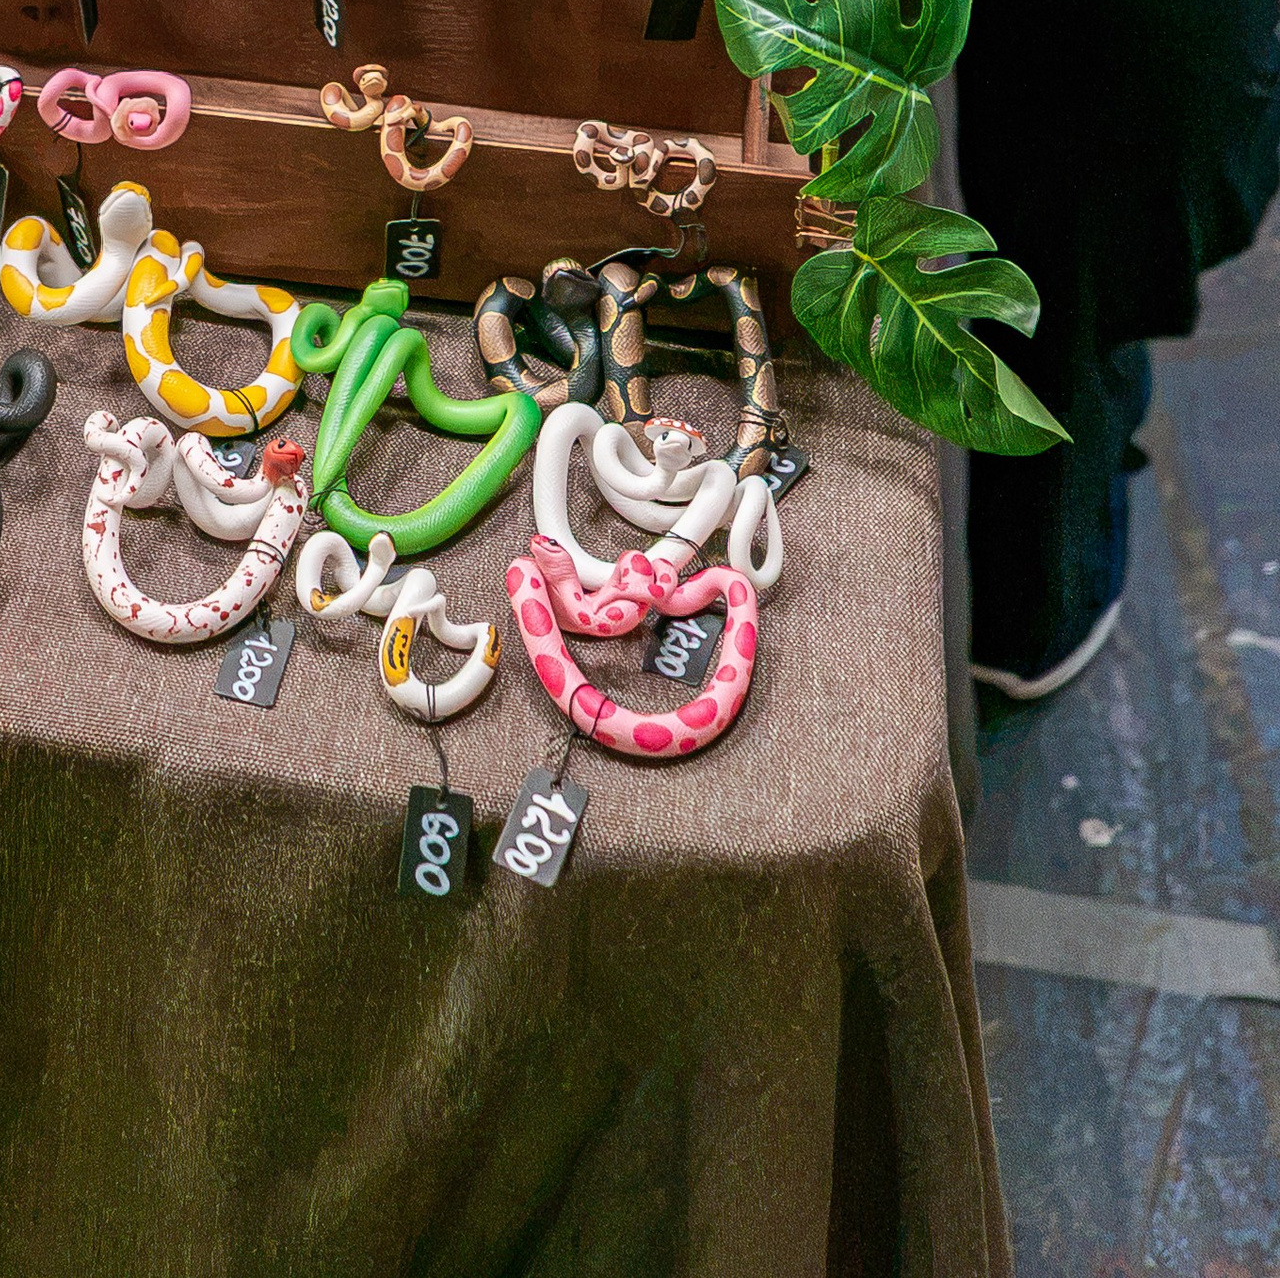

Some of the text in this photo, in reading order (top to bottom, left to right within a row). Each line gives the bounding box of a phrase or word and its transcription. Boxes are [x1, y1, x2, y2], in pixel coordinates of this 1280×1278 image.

[65, 208, 93, 265] 700
[395, 233, 435, 278] 700
[231, 635, 278, 702] 1200
[655, 619, 707, 680] 1200
[414, 811, 460, 897] 600
[503, 792, 578, 877] 1200
